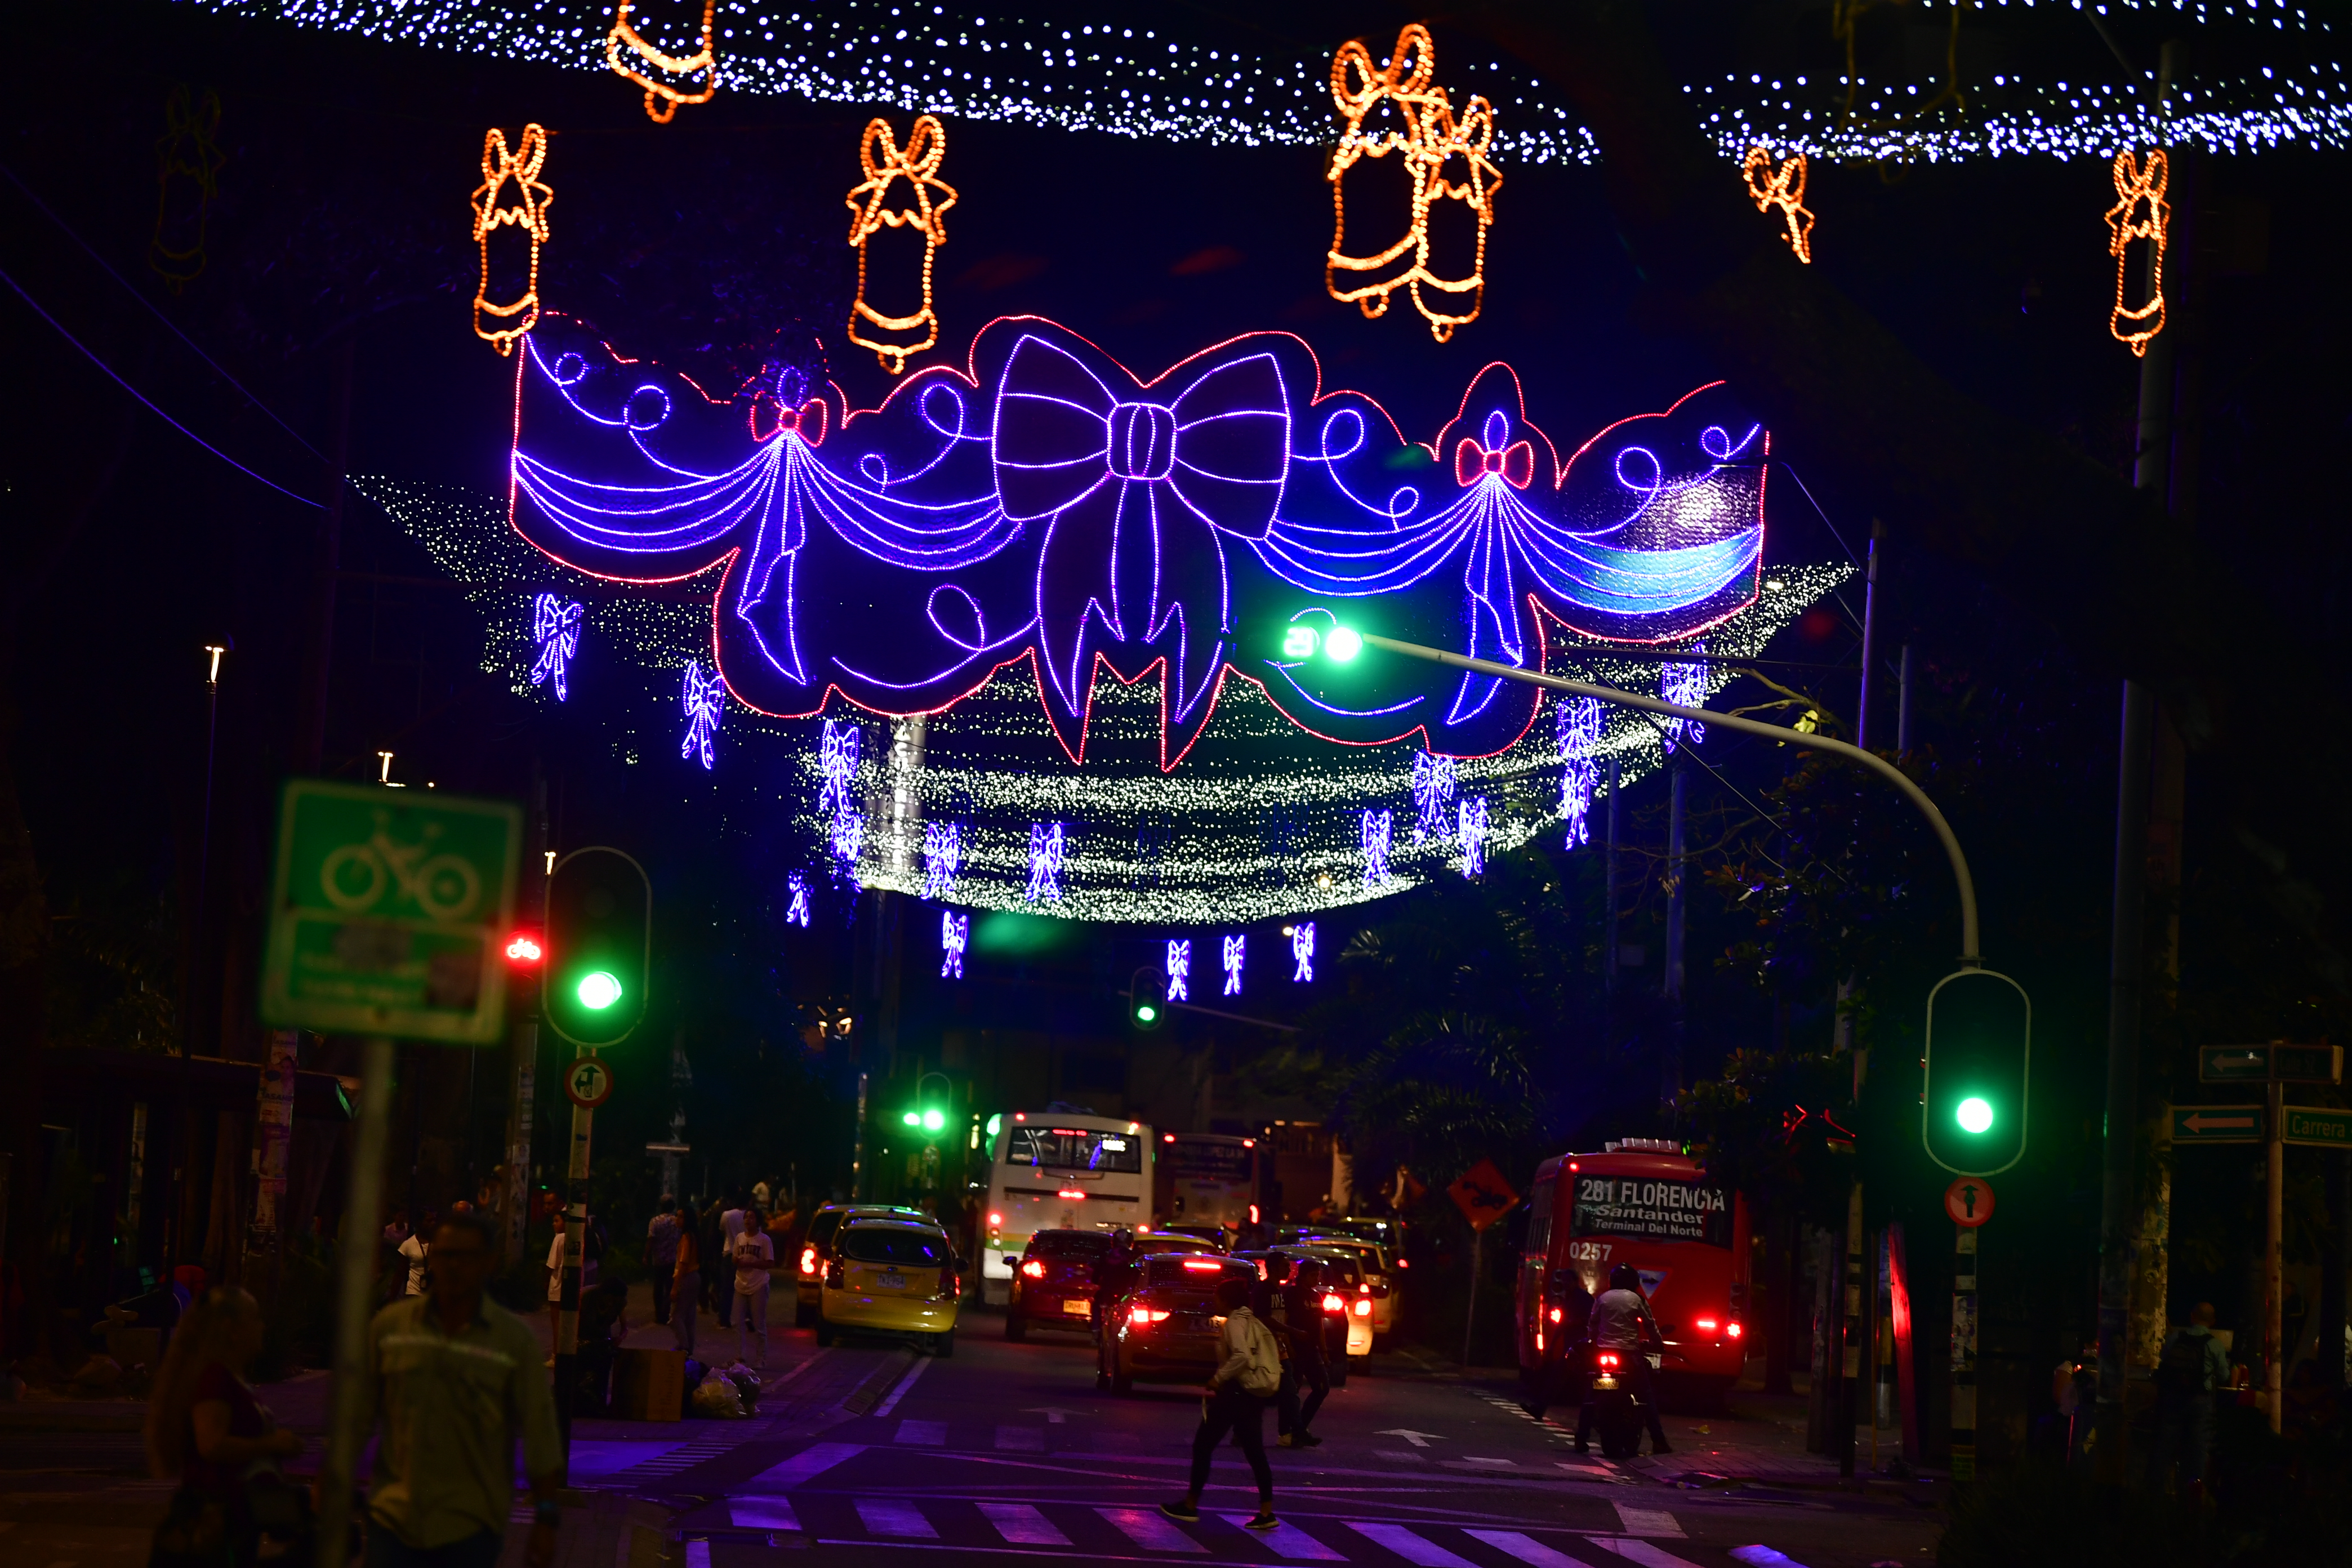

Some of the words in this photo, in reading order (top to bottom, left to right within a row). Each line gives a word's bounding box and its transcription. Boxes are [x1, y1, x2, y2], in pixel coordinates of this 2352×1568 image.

[2292, 1114, 2346, 1138] Carrera
[1581, 1179, 1612, 1202] 281
[1620, 1182, 1726, 1211] FLORENCIA
[1596, 1204, 1704, 1224] Santander
[1594, 1218, 1645, 1232] Terminal
[1649, 1222, 1667, 1234] Del
[1671, 1224, 1703, 1237] Norte
[1569, 1241, 1612, 1262] 0257
